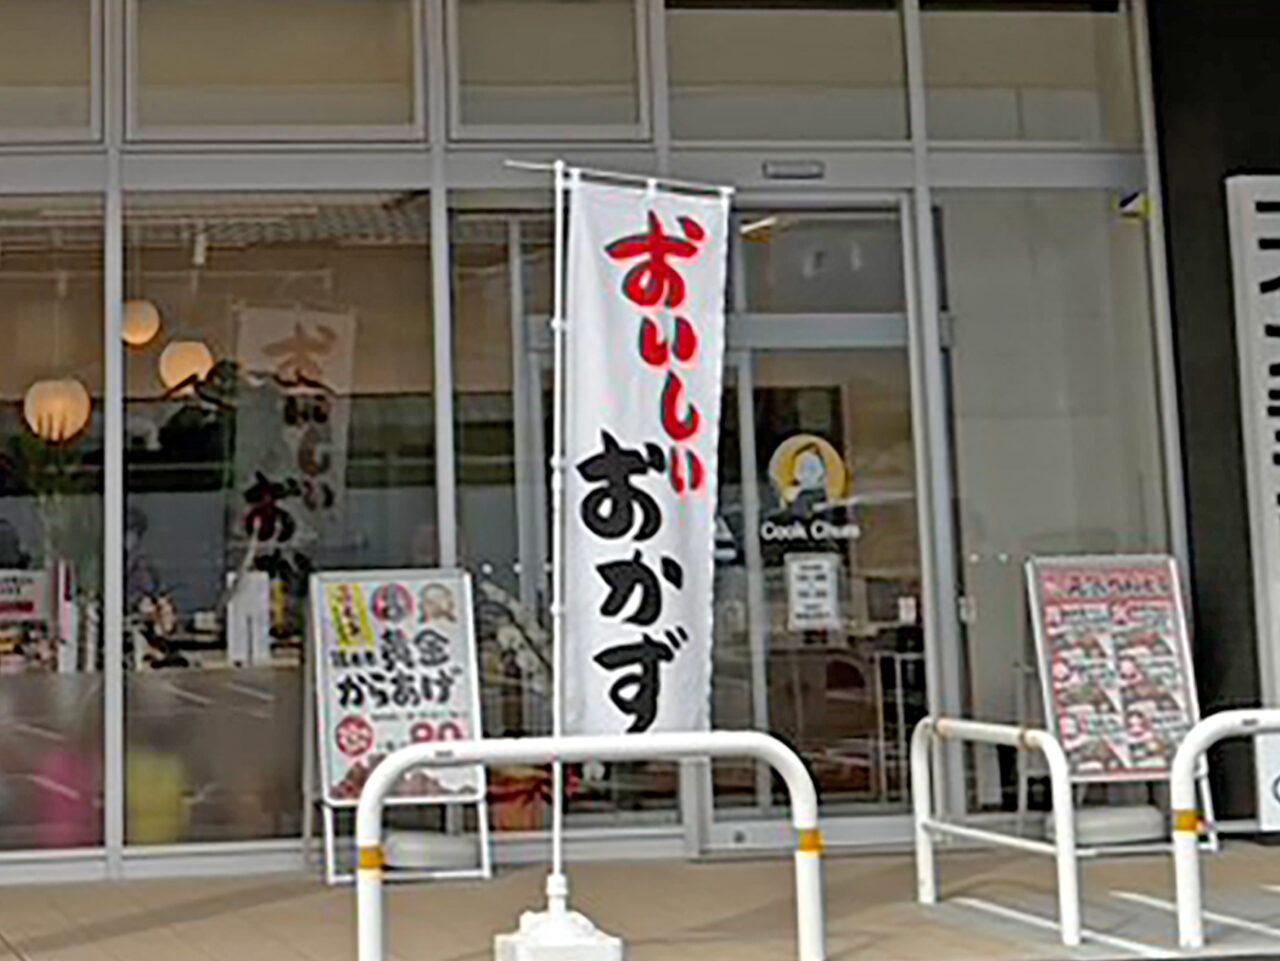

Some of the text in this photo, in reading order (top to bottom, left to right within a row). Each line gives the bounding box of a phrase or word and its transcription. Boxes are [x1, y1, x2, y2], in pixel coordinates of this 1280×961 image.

[604, 209, 705, 494] おいしい
[336, 665, 464, 709] からあげ
[577, 430, 687, 734] おかず
